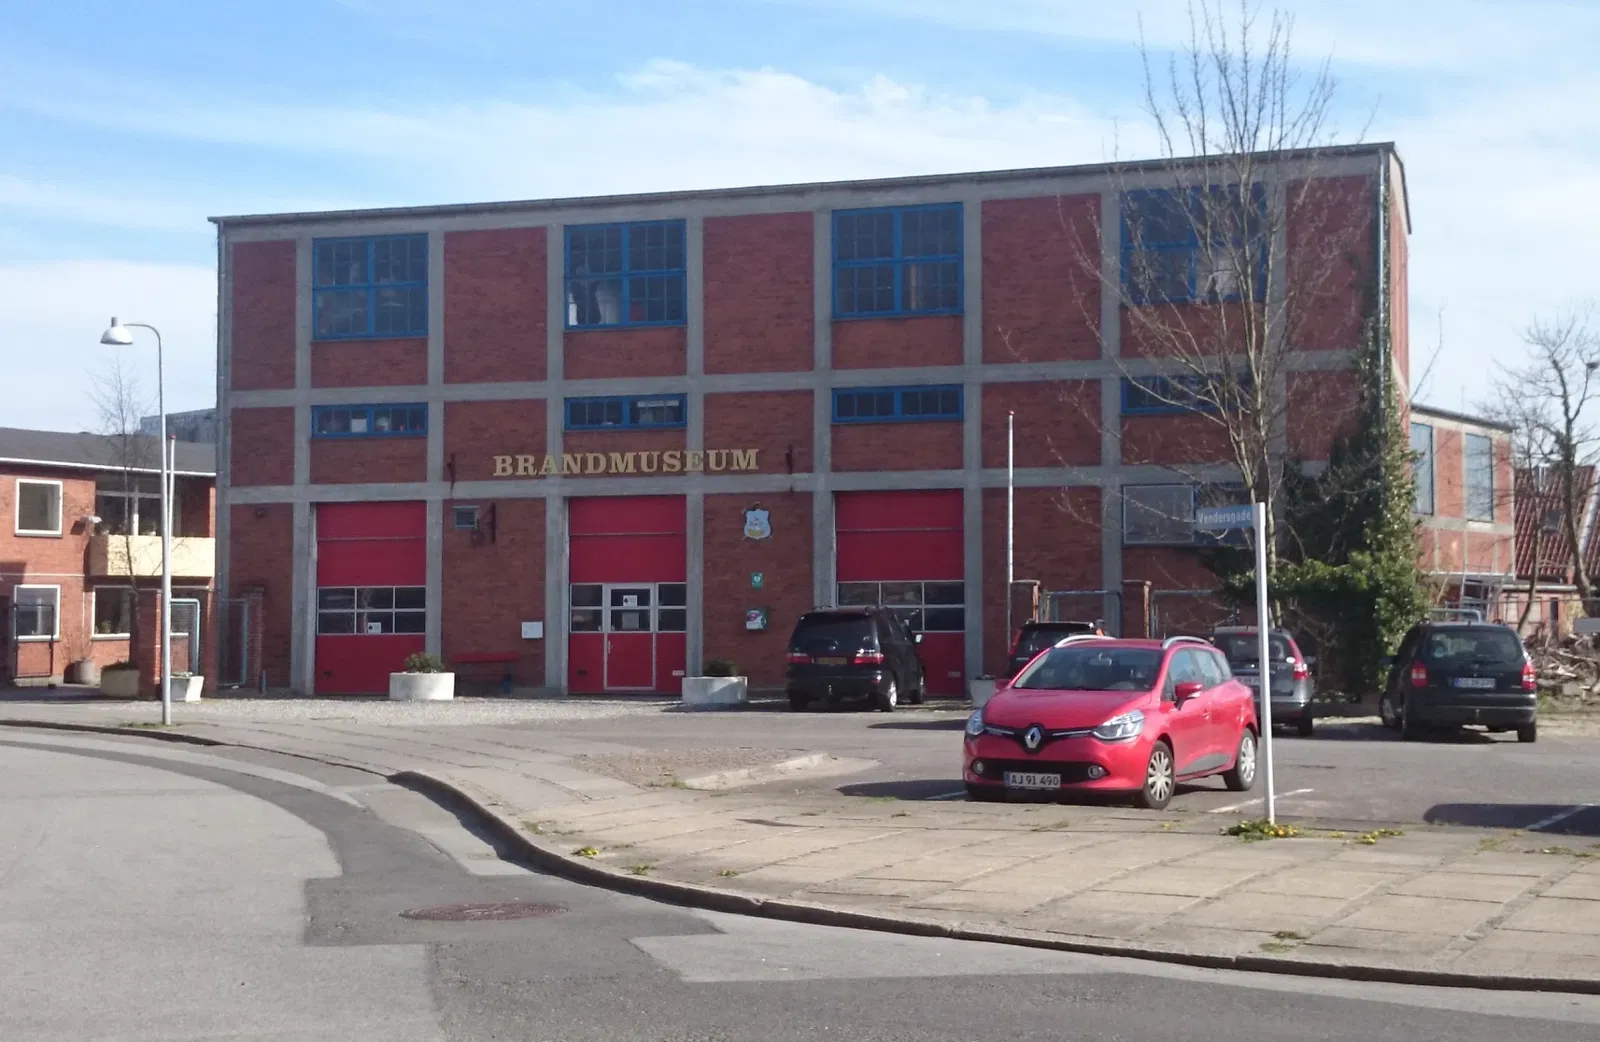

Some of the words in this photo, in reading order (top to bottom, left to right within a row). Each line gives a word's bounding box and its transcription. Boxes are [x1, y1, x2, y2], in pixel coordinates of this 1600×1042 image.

[493, 448, 759, 476] BRANDMUSEUM
[1011, 774, 1023, 785] AJ
[1026, 775, 1036, 786] 91
[1040, 776, 1059, 786] 490
